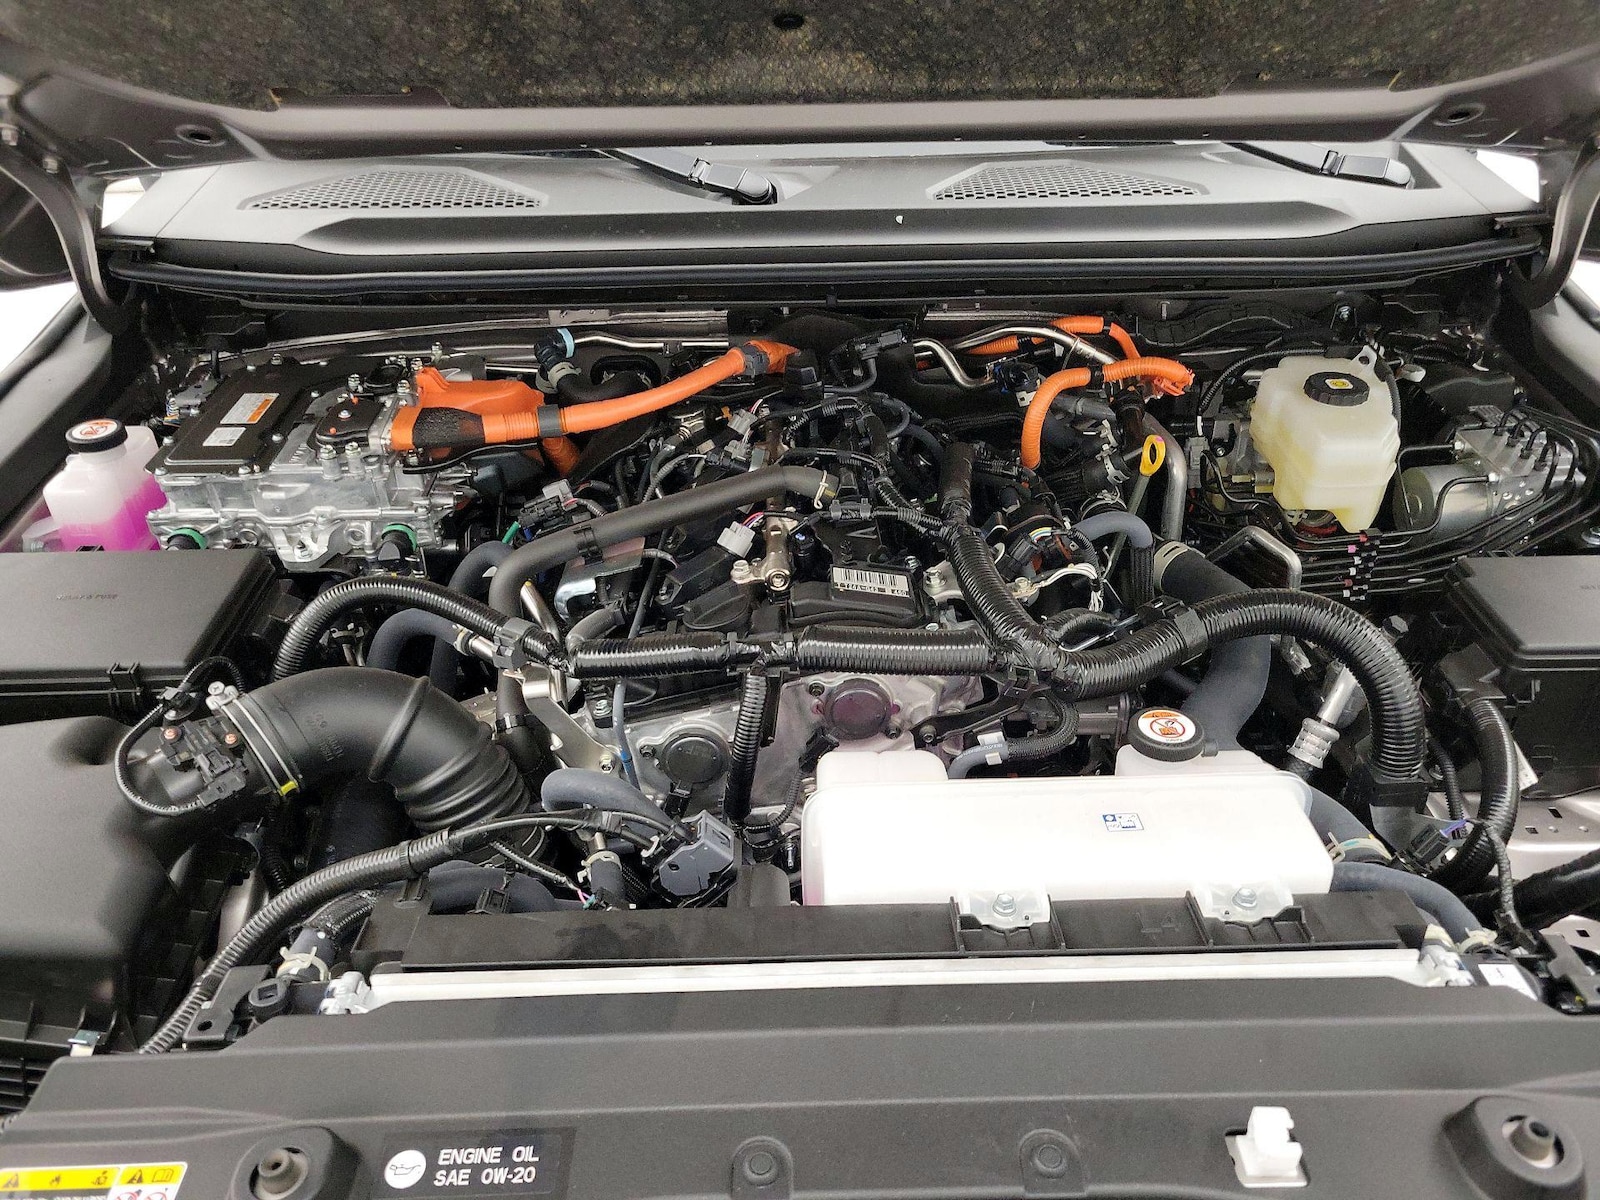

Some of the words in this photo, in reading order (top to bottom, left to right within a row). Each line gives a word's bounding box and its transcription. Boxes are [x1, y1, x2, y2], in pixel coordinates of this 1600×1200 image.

[438, 1147, 503, 1165] ENGINE
[512, 1145, 540, 1162] OIL
[433, 1169, 472, 1186] SAE
[481, 1166, 536, 1184] 0W-20
